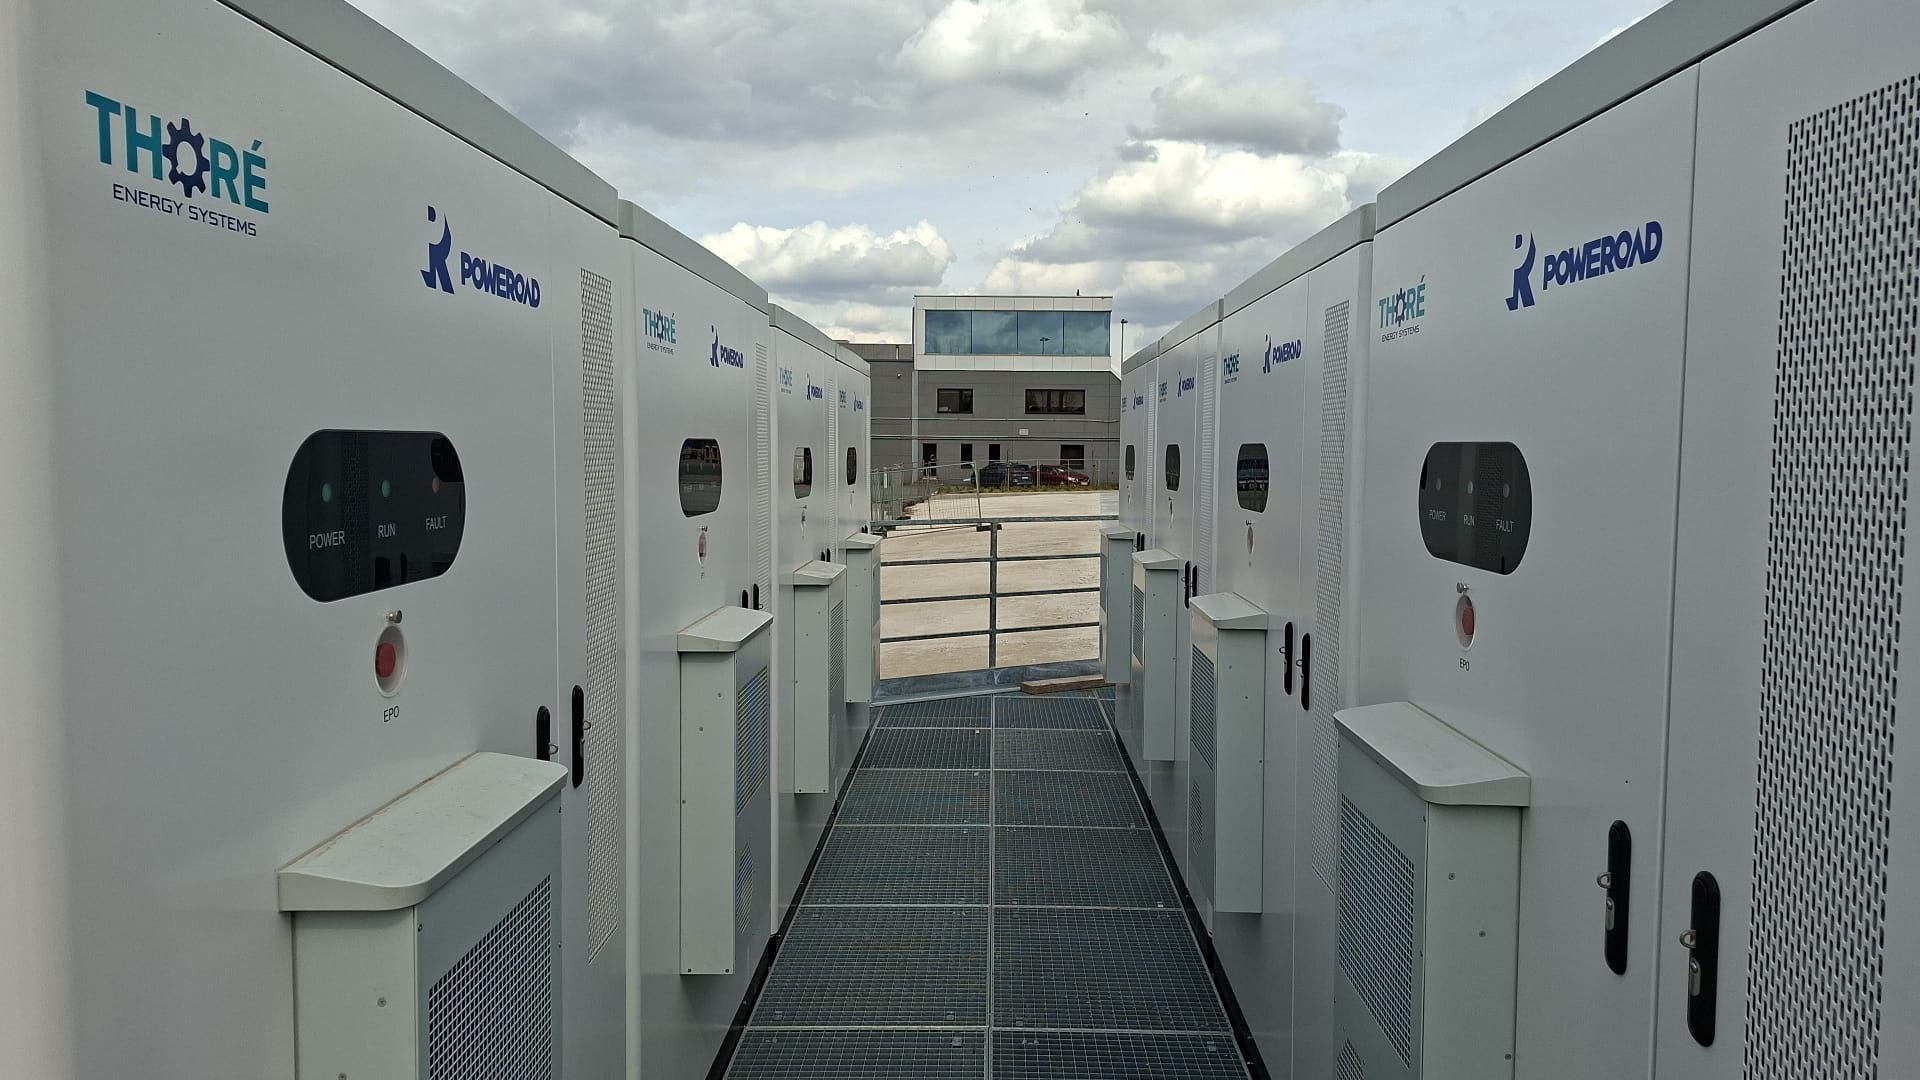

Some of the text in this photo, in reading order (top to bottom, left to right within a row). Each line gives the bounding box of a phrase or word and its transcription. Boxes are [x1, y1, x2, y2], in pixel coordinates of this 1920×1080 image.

[85, 90, 269, 214] THORÉ
[112, 183, 257, 237] ENERGY SYSTEMS
[1543, 221, 1663, 290] POWEROAD
[460, 251, 540, 308] POWEROAD
[1379, 274, 1425, 329] THORÉ
[642, 308, 677, 345] THORÉ
[1381, 325, 1420, 342] ENERGY SYSTEMS
[720, 345, 744, 369] POWEROAD
[1272, 340, 1301, 365] POWEROAD
[309, 515, 447, 549] POWER RUN FAULT
[1429, 509, 1515, 533] POWER RUN FAULT
[1459, 657, 1470, 672] EPO
[383, 705, 400, 723] EPO
